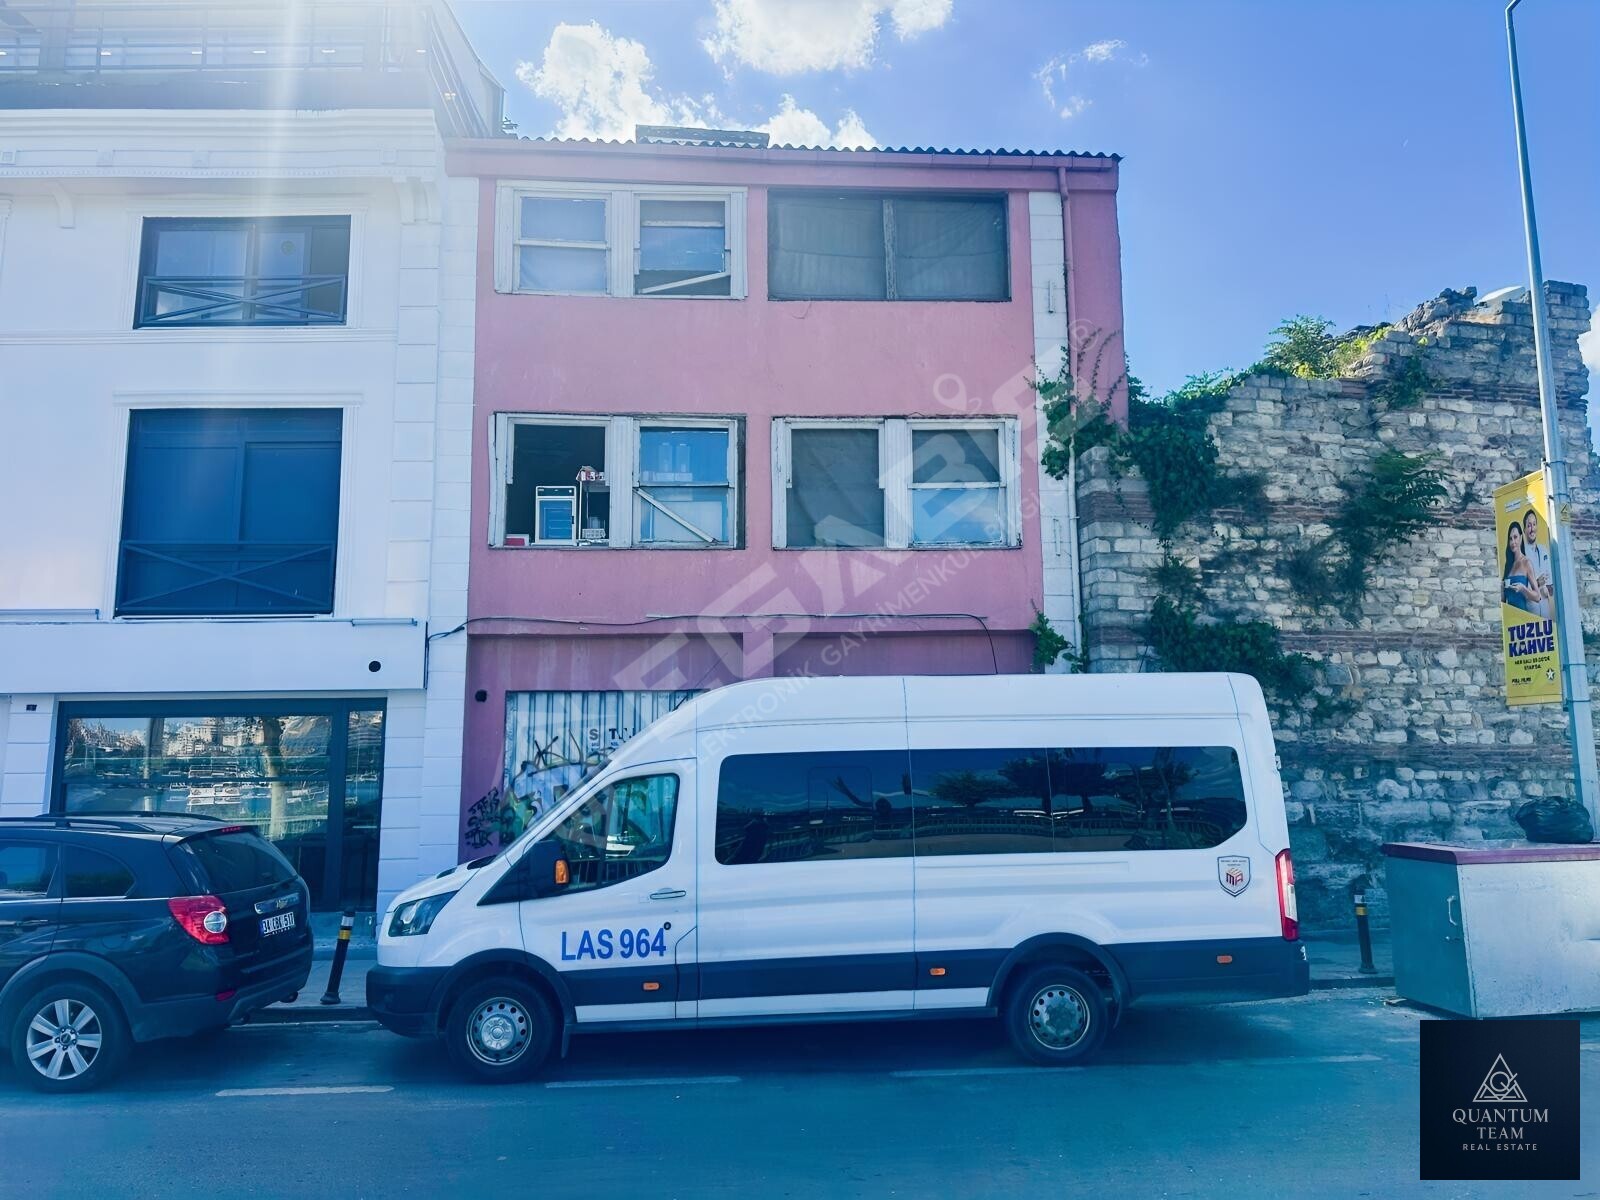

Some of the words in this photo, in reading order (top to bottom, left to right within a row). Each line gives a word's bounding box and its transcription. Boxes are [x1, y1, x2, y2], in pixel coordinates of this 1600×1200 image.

[1508, 619, 1553, 642] TUZLU
[1508, 636, 1555, 658] KAHVE
[561, 928, 614, 961] LAS
[619, 927, 667, 959] 964
